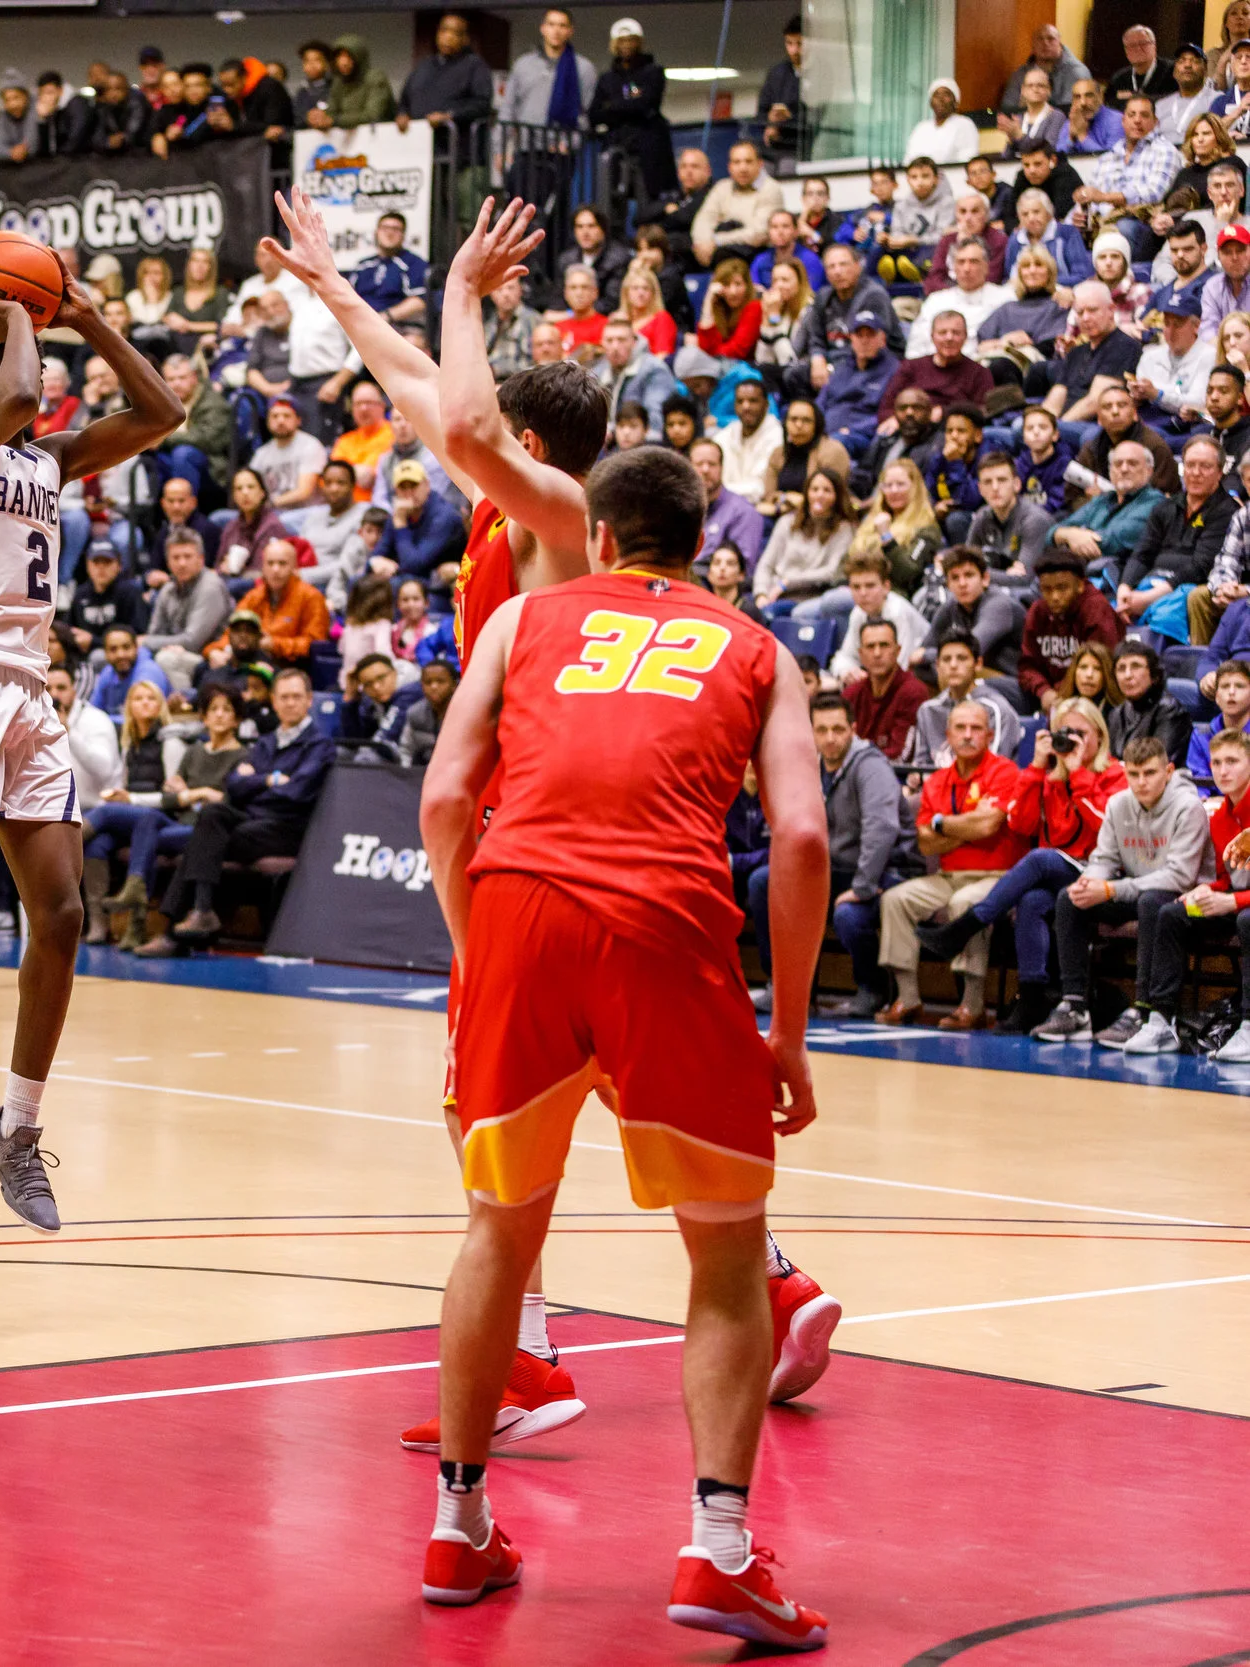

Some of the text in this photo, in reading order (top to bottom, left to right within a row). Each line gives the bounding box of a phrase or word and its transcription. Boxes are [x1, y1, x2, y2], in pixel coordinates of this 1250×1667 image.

[82, 188, 224, 250] Group
[27, 530, 53, 604] 2
[554, 609, 733, 702] 32
